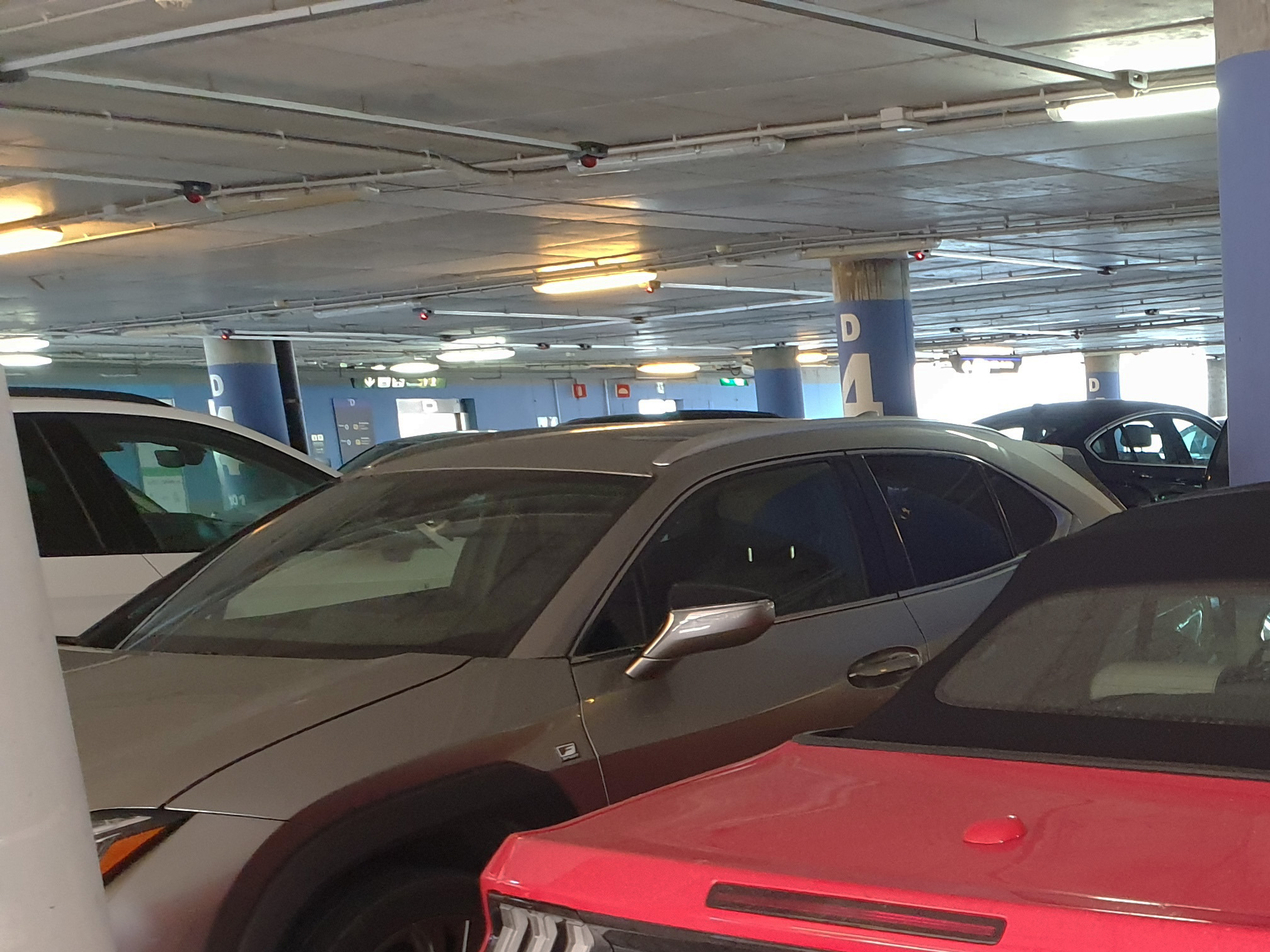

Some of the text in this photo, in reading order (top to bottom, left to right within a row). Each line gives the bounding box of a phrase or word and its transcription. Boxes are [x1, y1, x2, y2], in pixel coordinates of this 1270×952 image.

[840, 314, 861, 342] D
[209, 374, 224, 397] D
[1088, 377, 1100, 393] D
